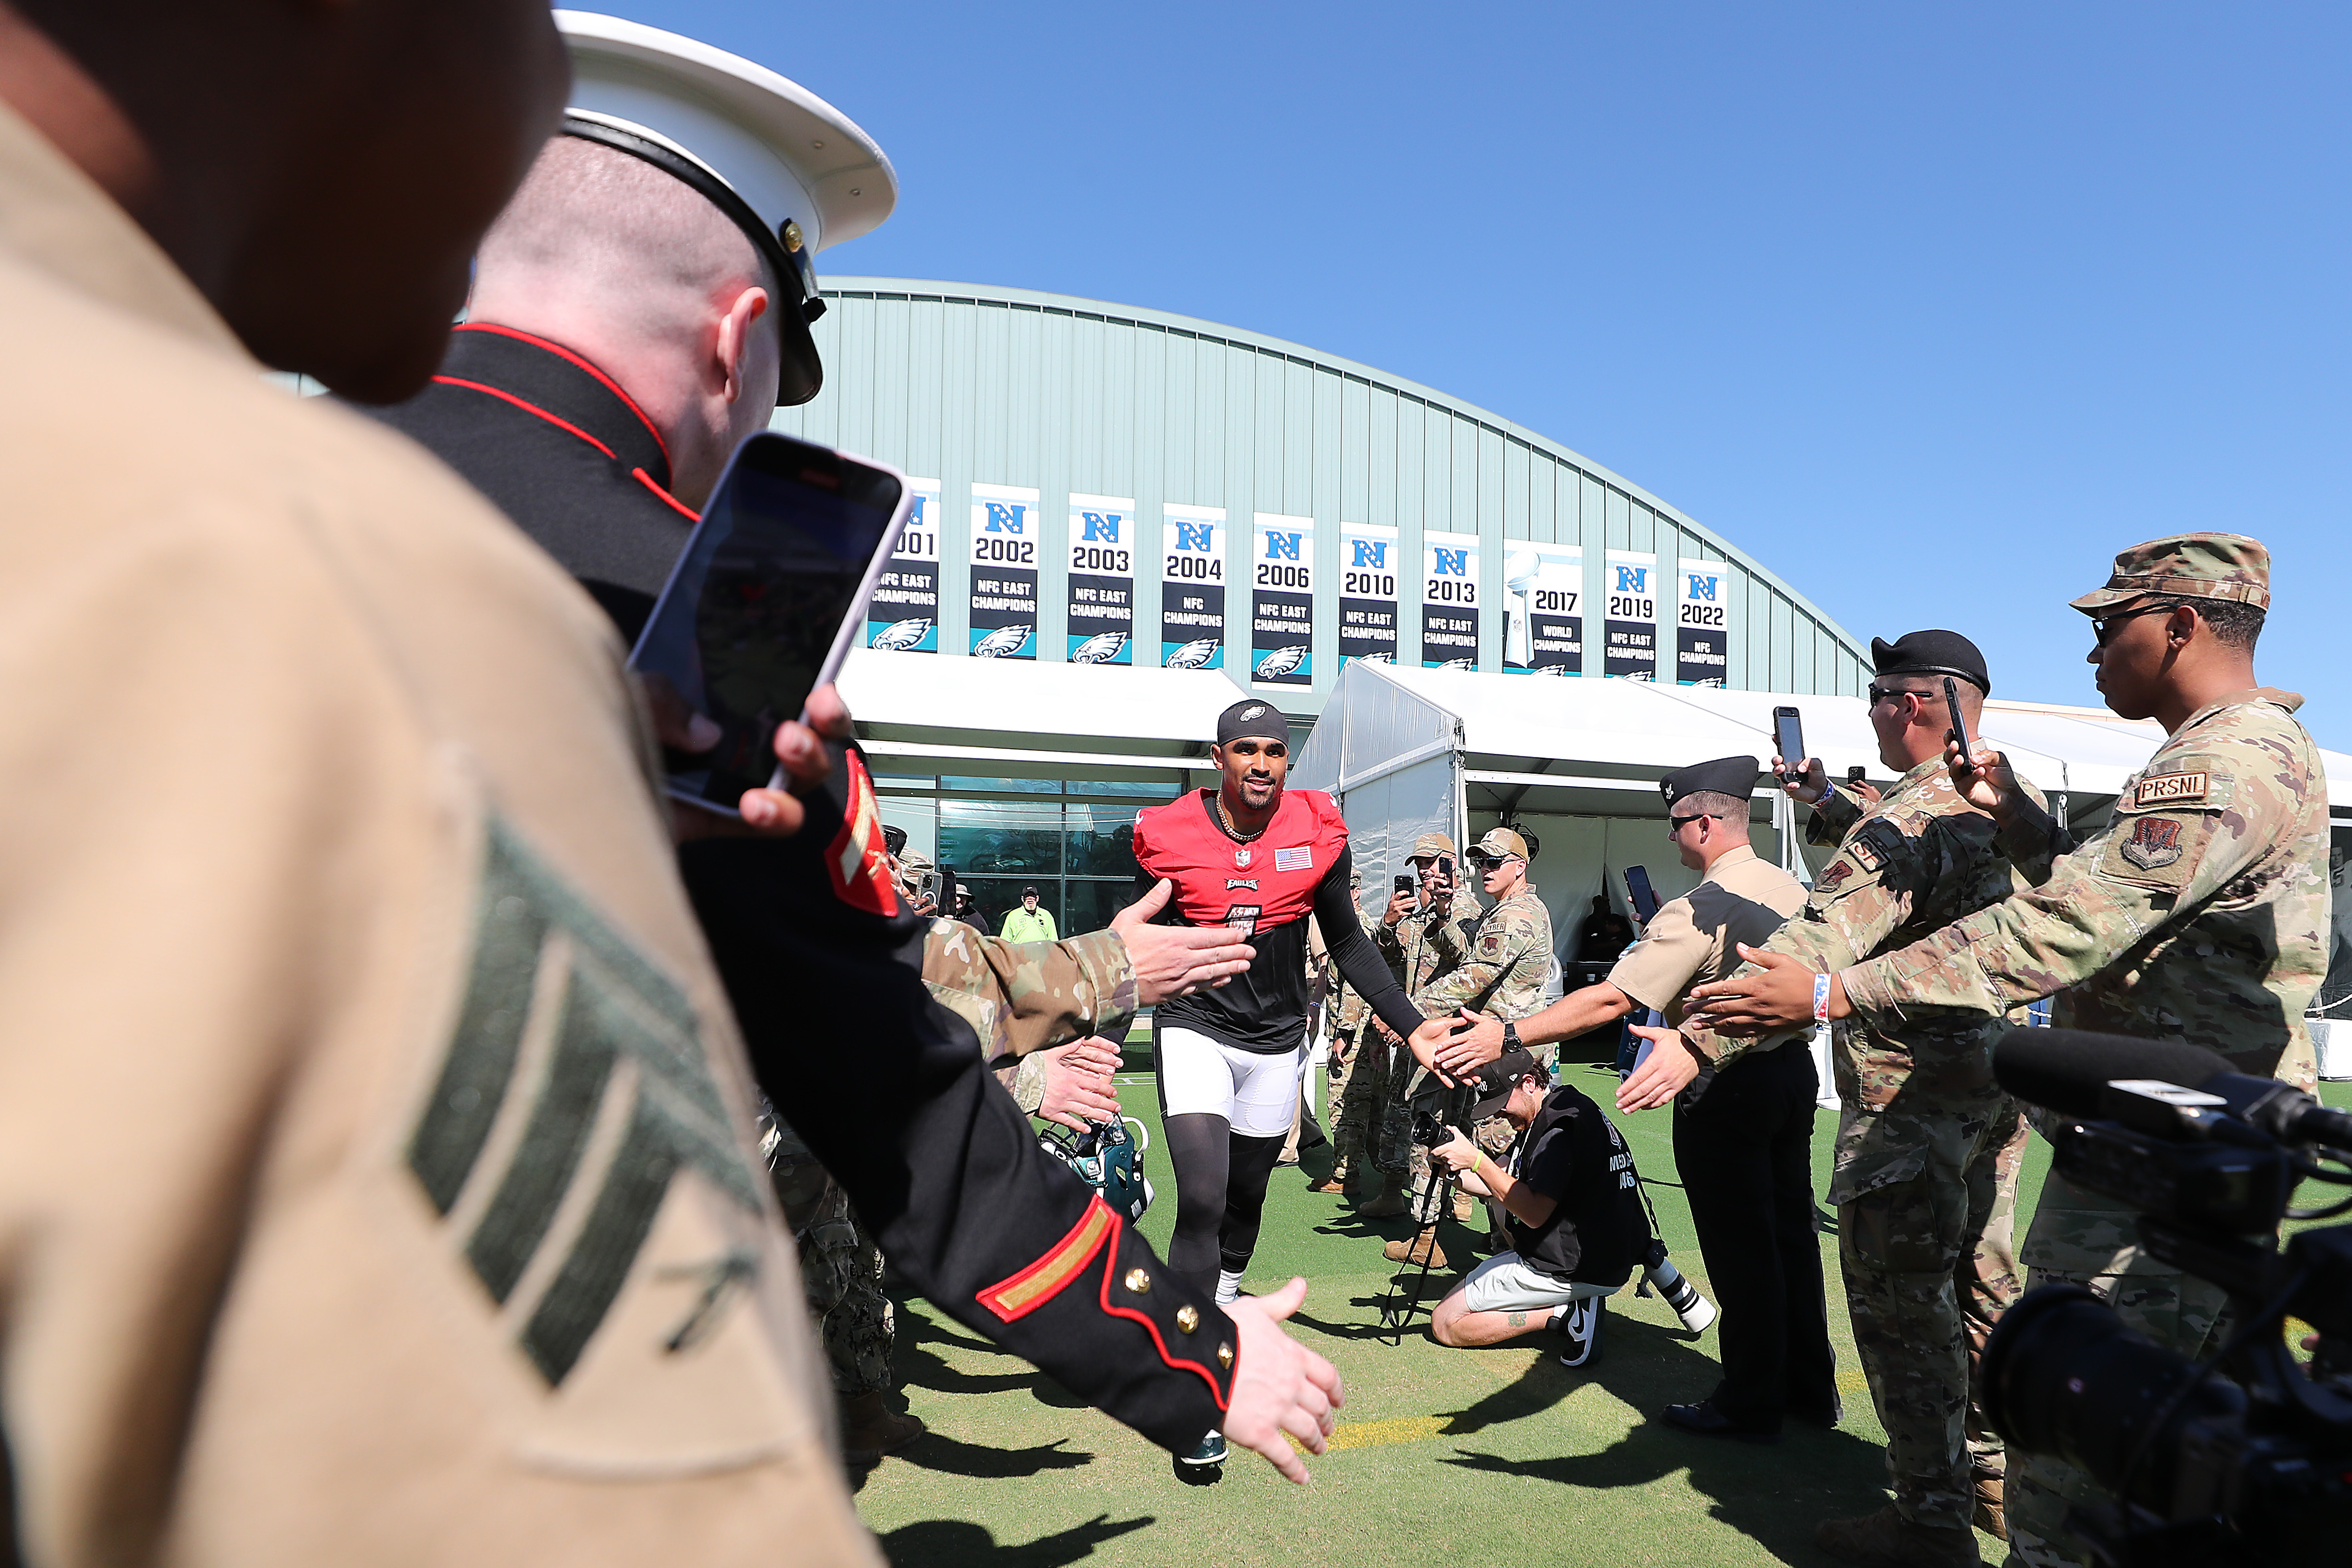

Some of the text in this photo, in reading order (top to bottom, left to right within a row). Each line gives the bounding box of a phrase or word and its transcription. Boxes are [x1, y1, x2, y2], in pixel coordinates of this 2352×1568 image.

[896, 530, 933, 555] 001
[976, 538, 1033, 563] 2002
[1073, 546, 1128, 572] 2003
[1167, 556, 1222, 580] 2004
[1258, 564, 1309, 588] 2006
[902, 574, 931, 589] EAST
[977, 579, 1031, 596] NFC EAST
[1346, 572, 1394, 596] 2010
[1075, 587, 1127, 603] NFC EAST
[1428, 579, 1475, 603] 2013
[972, 596, 1035, 612] CHAMPIONS
[1183, 597, 1203, 610] NFC
[1536, 590, 1577, 612] 2017
[1611, 596, 1652, 618] 2019
[1070, 603, 1131, 620] CHAMPIONS
[1259, 603, 1307, 618] NFC EAST
[1346, 611, 1391, 625] NFC EAST
[1681, 604, 1723, 626] 2022
[1164, 611, 1223, 627] CHAMPIONS
[1254, 619, 1311, 634] CHAMPIONS
[1428, 617, 1473, 632] NFC EAST
[1341, 626, 1396, 641] CHAMPIONS
[1424, 632, 1476, 647] CHAMPIONS
[1542, 625, 1572, 638] WORLD
[1611, 632, 1651, 646] NFC EAST
[1534, 639, 1581, 653] CHAMPIONS
[1607, 646, 1655, 661] CHAMPIONS
[1694, 641, 1711, 653] NFC
[1679, 651, 1725, 665] CHAMPIONS
[2141, 776, 2205, 798] PRSNL
[1855, 841, 1885, 864] SF
[1485, 923, 1504, 932] CYBER
[1610, 1151, 1632, 1172] MEDA
